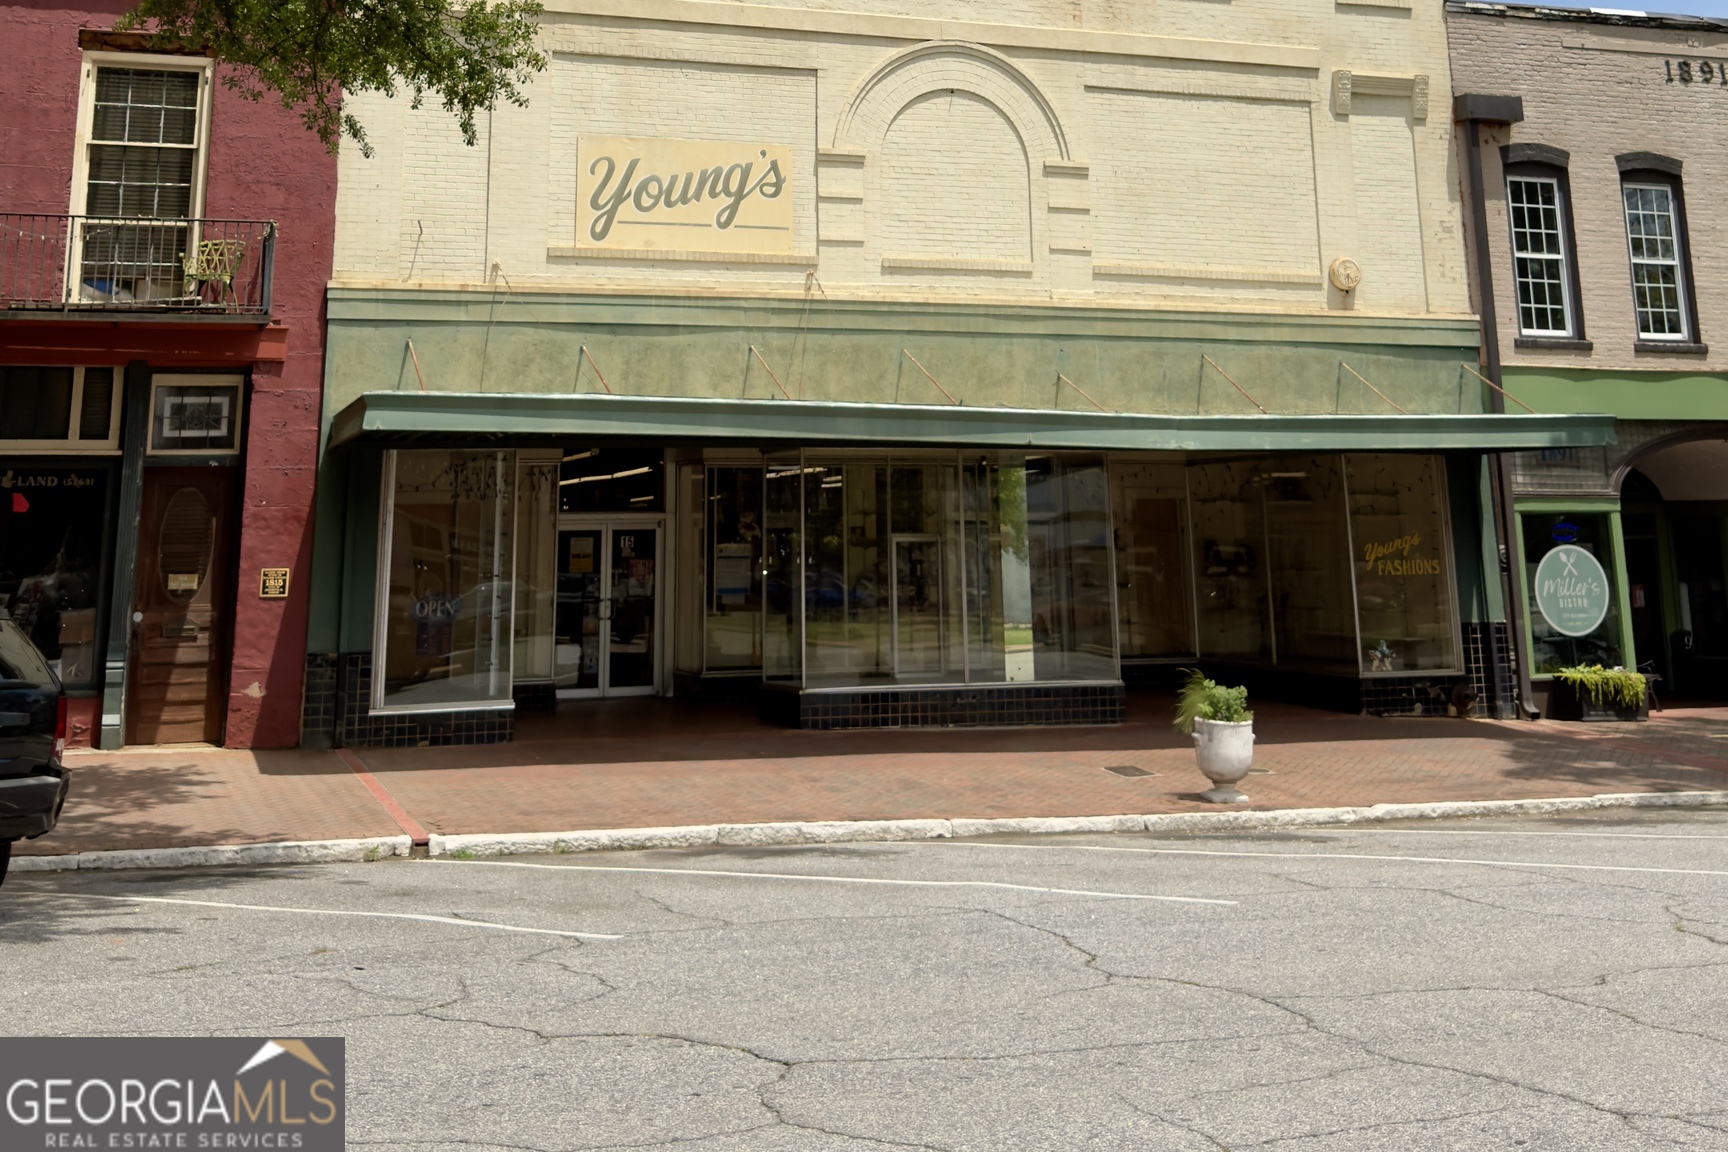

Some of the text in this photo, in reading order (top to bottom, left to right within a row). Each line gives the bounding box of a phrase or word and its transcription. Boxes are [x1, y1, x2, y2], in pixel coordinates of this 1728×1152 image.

[1664, 59, 1728, 88] 1891
[589, 149, 787, 241] Young's
[622, 535, 634, 547] 15
[1377, 559, 1440, 576] FASHIONS
[1543, 577, 1601, 598] Miller's
[415, 599, 456, 618] OPEN
[1559, 597, 1588, 608] BISTRO
